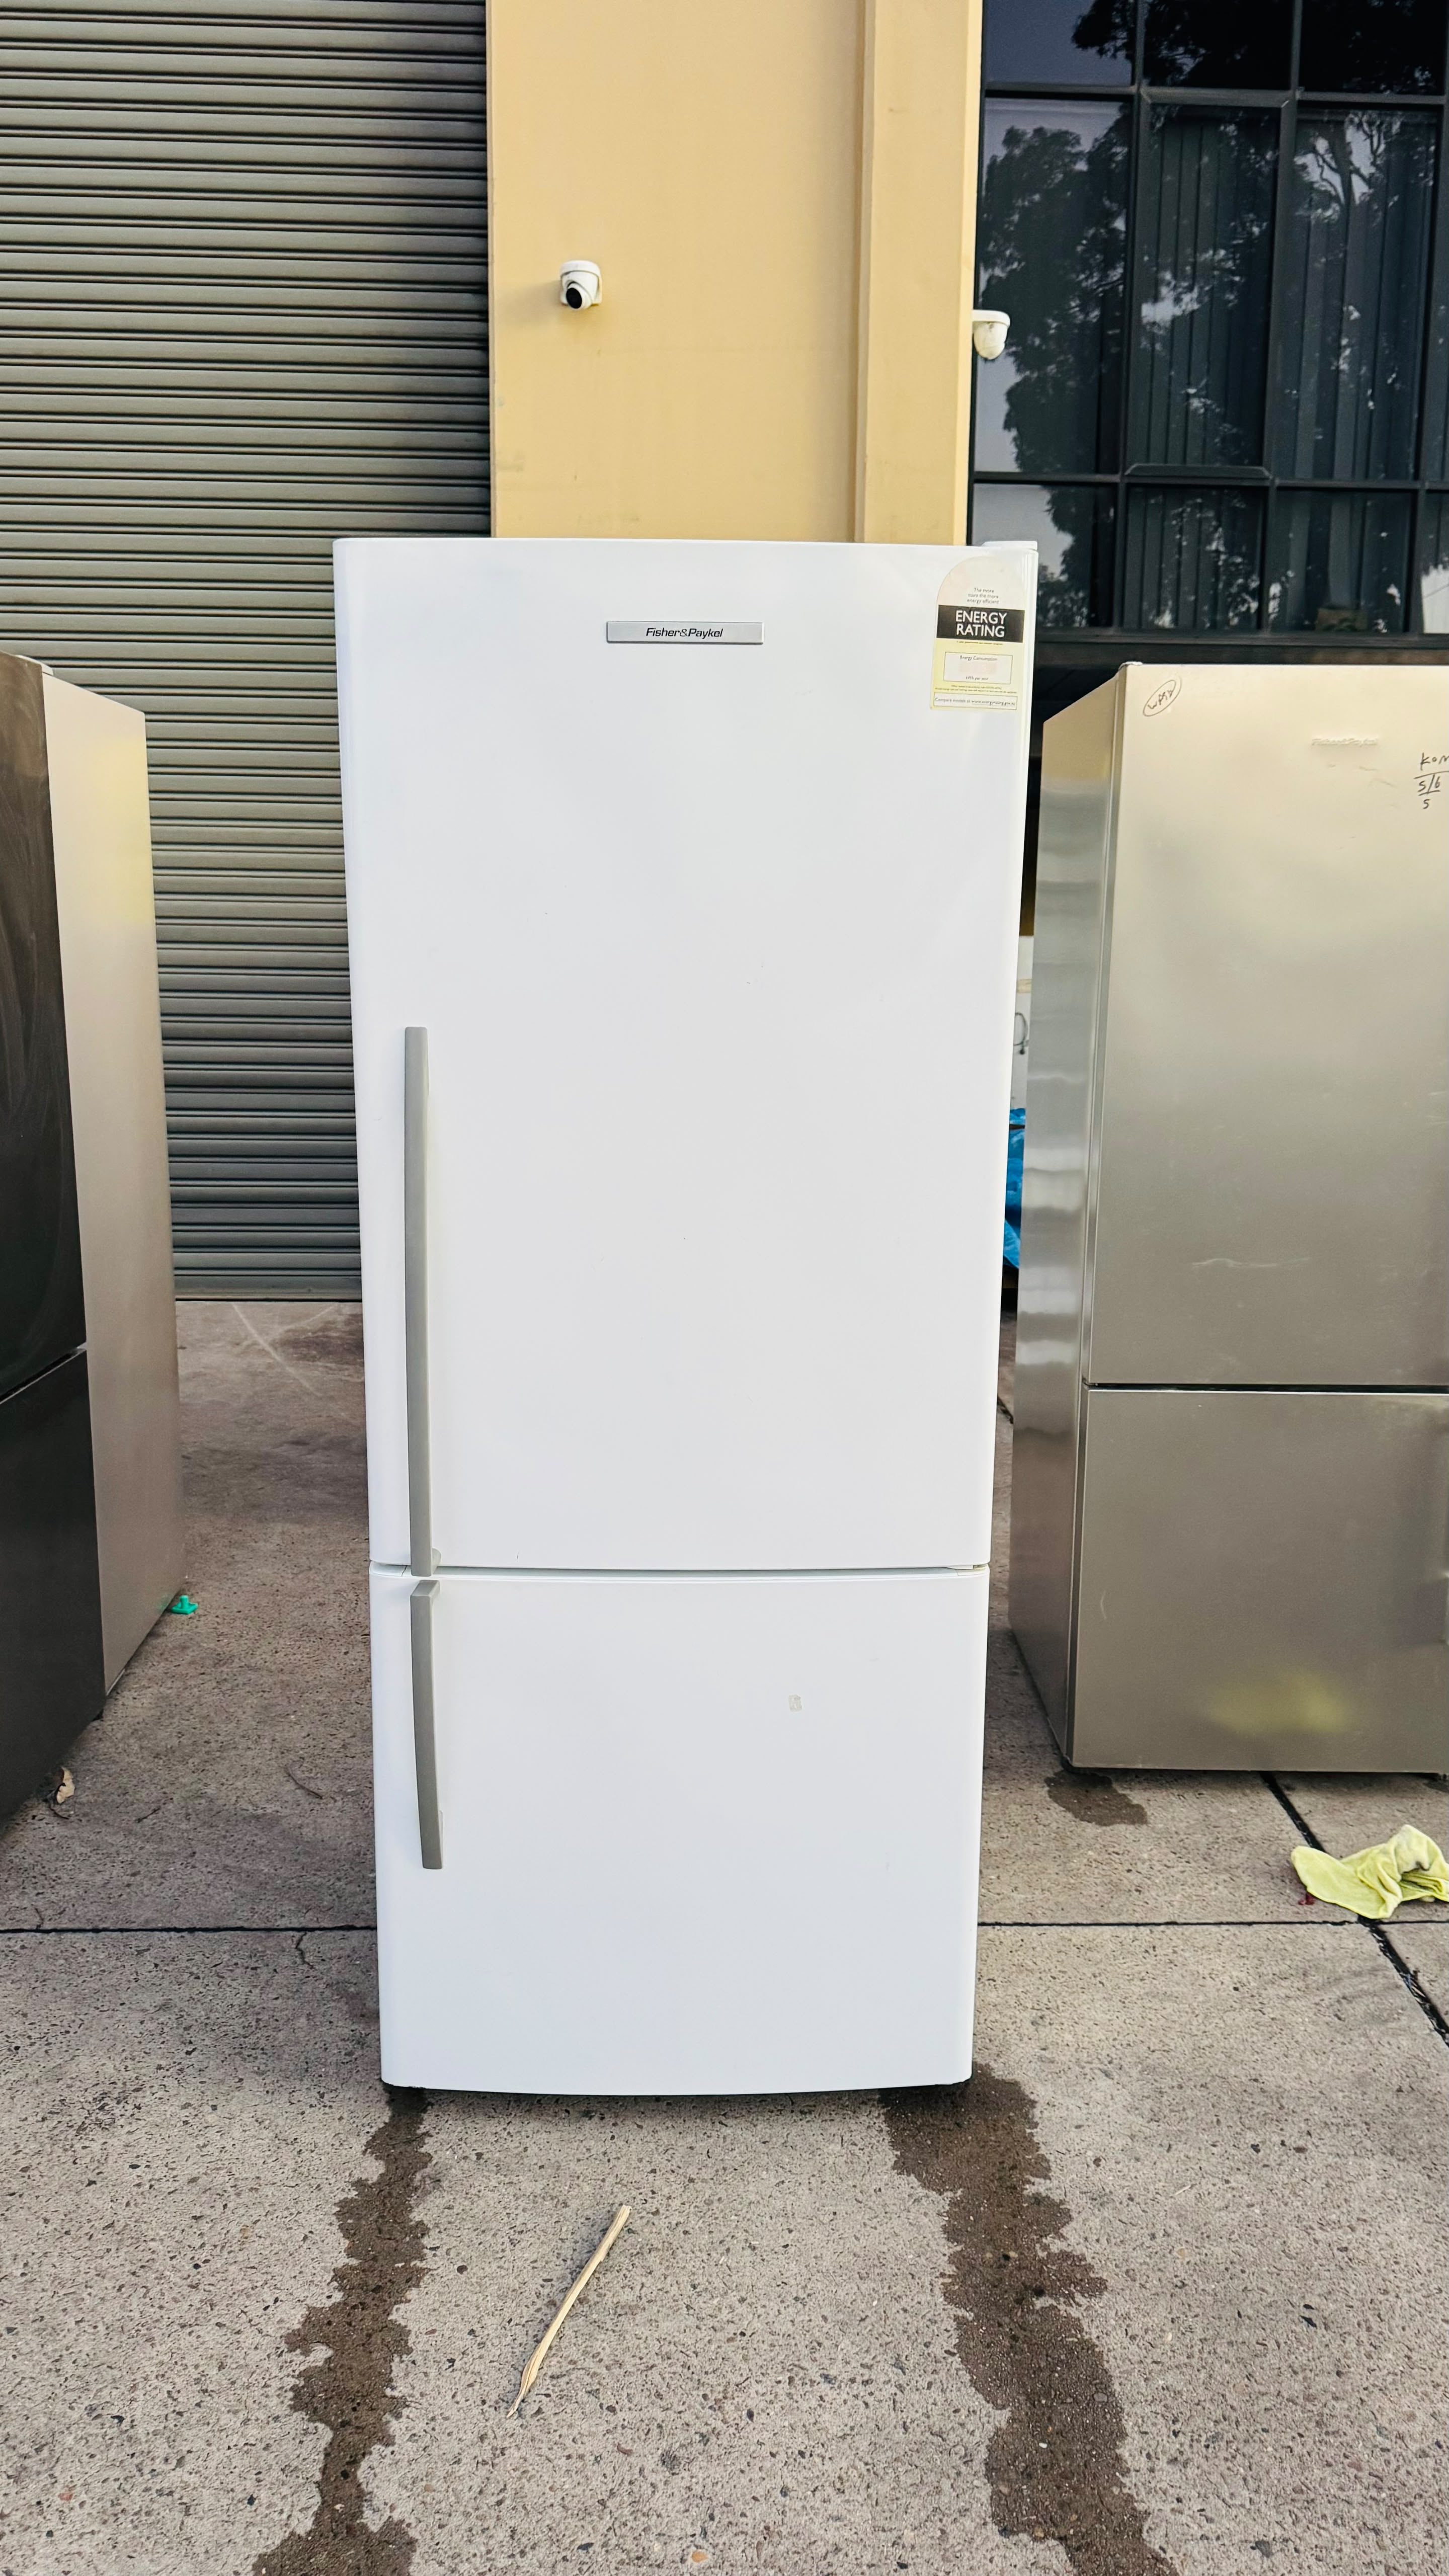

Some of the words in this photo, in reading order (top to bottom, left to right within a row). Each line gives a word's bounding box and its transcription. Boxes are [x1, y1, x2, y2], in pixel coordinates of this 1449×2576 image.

[956, 610, 1007, 624] ENERGY
[646, 627, 723, 639] Fisher&Paykel
[956, 623, 1005, 637] RATING
